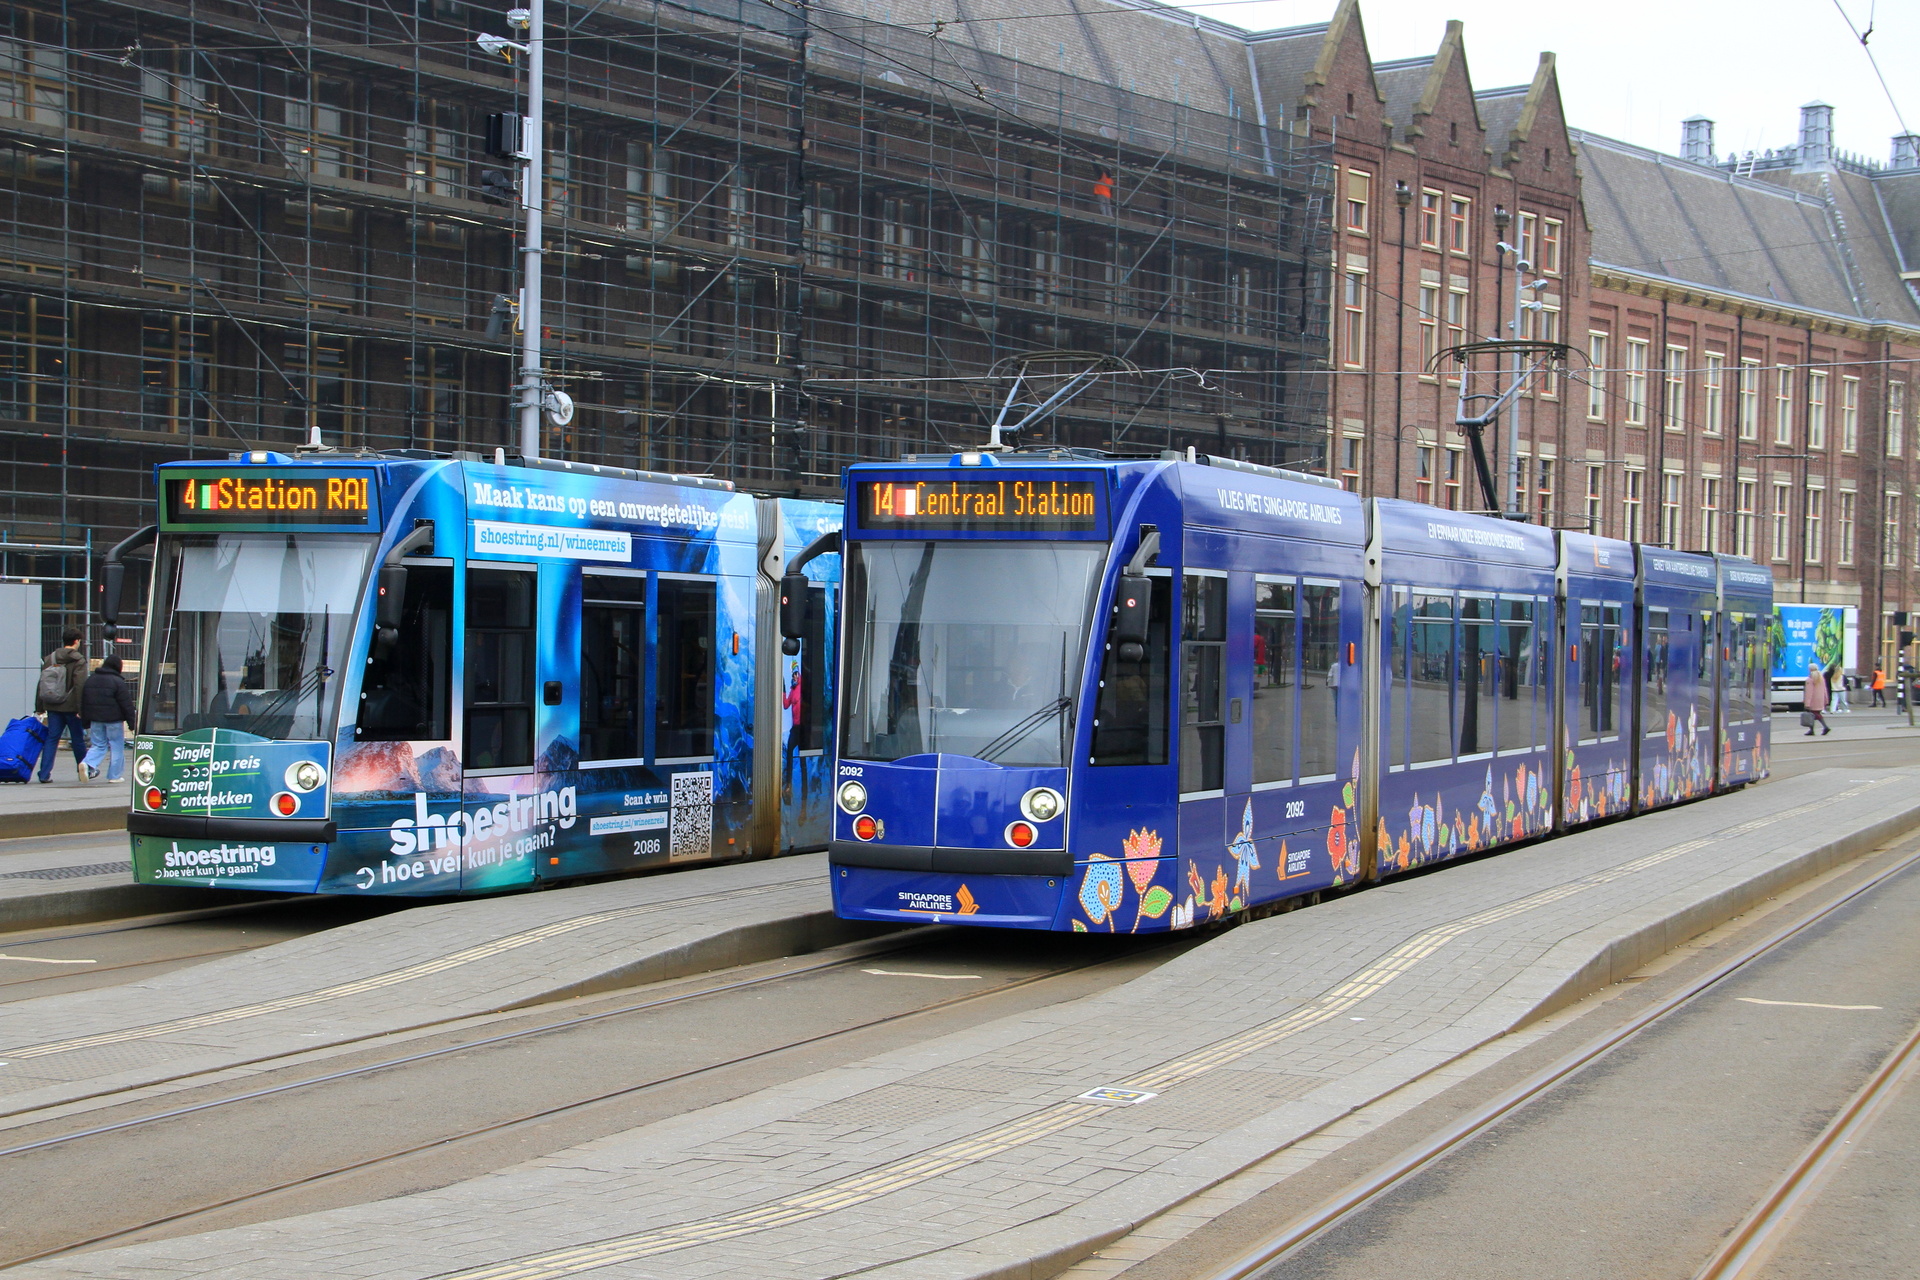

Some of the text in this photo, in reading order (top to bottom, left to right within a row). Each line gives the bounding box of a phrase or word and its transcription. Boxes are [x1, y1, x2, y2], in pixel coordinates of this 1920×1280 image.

[184, 477, 368, 510] 4 Station RAI
[873, 482, 1094, 515] 14 Centraal Station
[474, 482, 749, 531] Maak kans op een onvergetelijke reis!
[1217, 488, 1342, 525] VLIEG MET SINGAPORE AIRLINES
[480, 529, 626, 553] shoestring.nl/wineenreis
[1427, 523, 1525, 551] EN ERVAAR ONZE BEKROONDE SERVICE
[137, 741, 154, 750] 2086
[173, 745, 211, 762] Single
[212, 755, 261, 774] op reis
[839, 766, 864, 777] 2092
[171, 779, 213, 793] Samen
[181, 791, 253, 807] ontdekken
[624, 791, 668, 806] Scan & win
[1286, 800, 1304, 818] 2092
[390, 785, 577, 856] shoestring
[592, 816, 665, 831] shoestring.nl/wineenreis
[164, 842, 276, 868] shoestring
[382, 825, 556, 884] hoe vér kun je gaan?
[633, 839, 661, 855] 2086
[1287, 849, 1311, 863] SINGAPORE
[163, 862, 259, 878] hoe vér kun je gaan?
[1287, 860, 1307, 873] AIRLINES
[898, 891, 952, 903] SINGAPORE
[909, 900, 952, 910] AIRLINES
